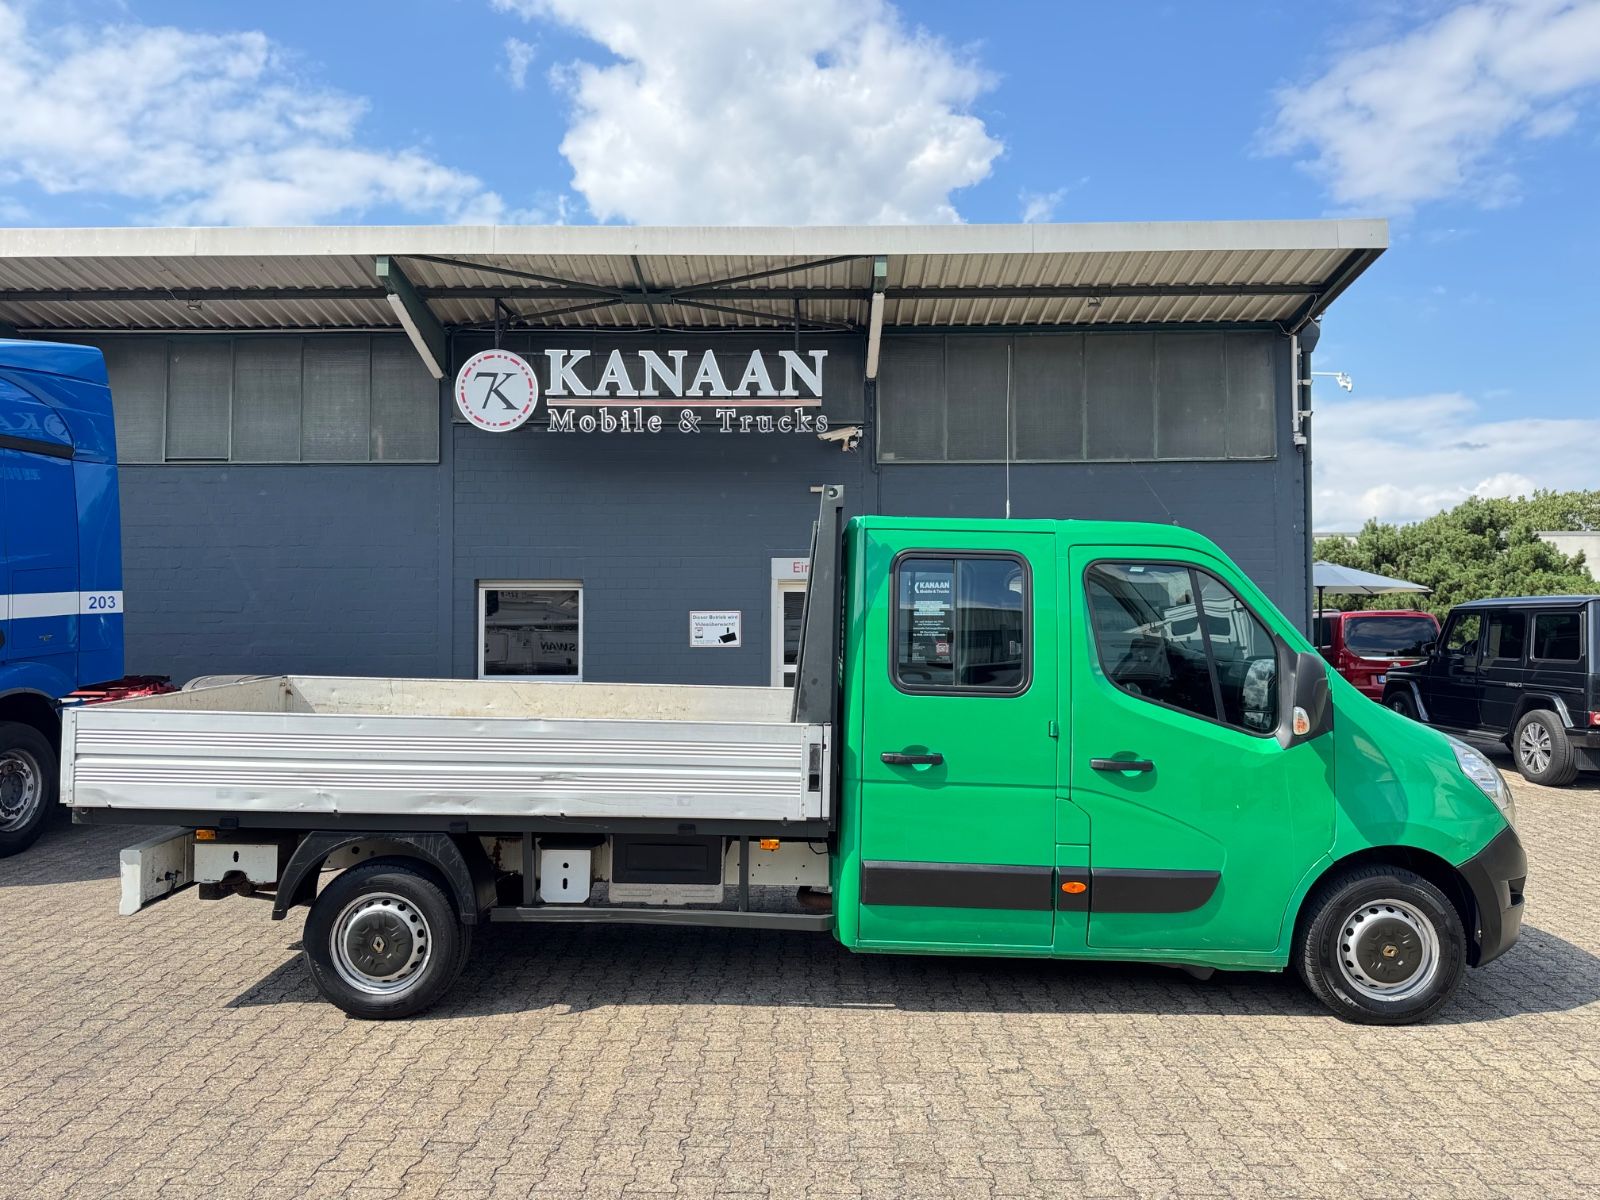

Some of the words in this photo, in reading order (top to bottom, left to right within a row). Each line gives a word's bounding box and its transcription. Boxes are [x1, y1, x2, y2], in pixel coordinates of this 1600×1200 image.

[544, 349, 828, 397] KANAAN
[547, 408, 663, 433] Mobile
[678, 410, 702, 433] &
[715, 407, 829, 433] Trucks
[88, 596, 116, 609] 203
